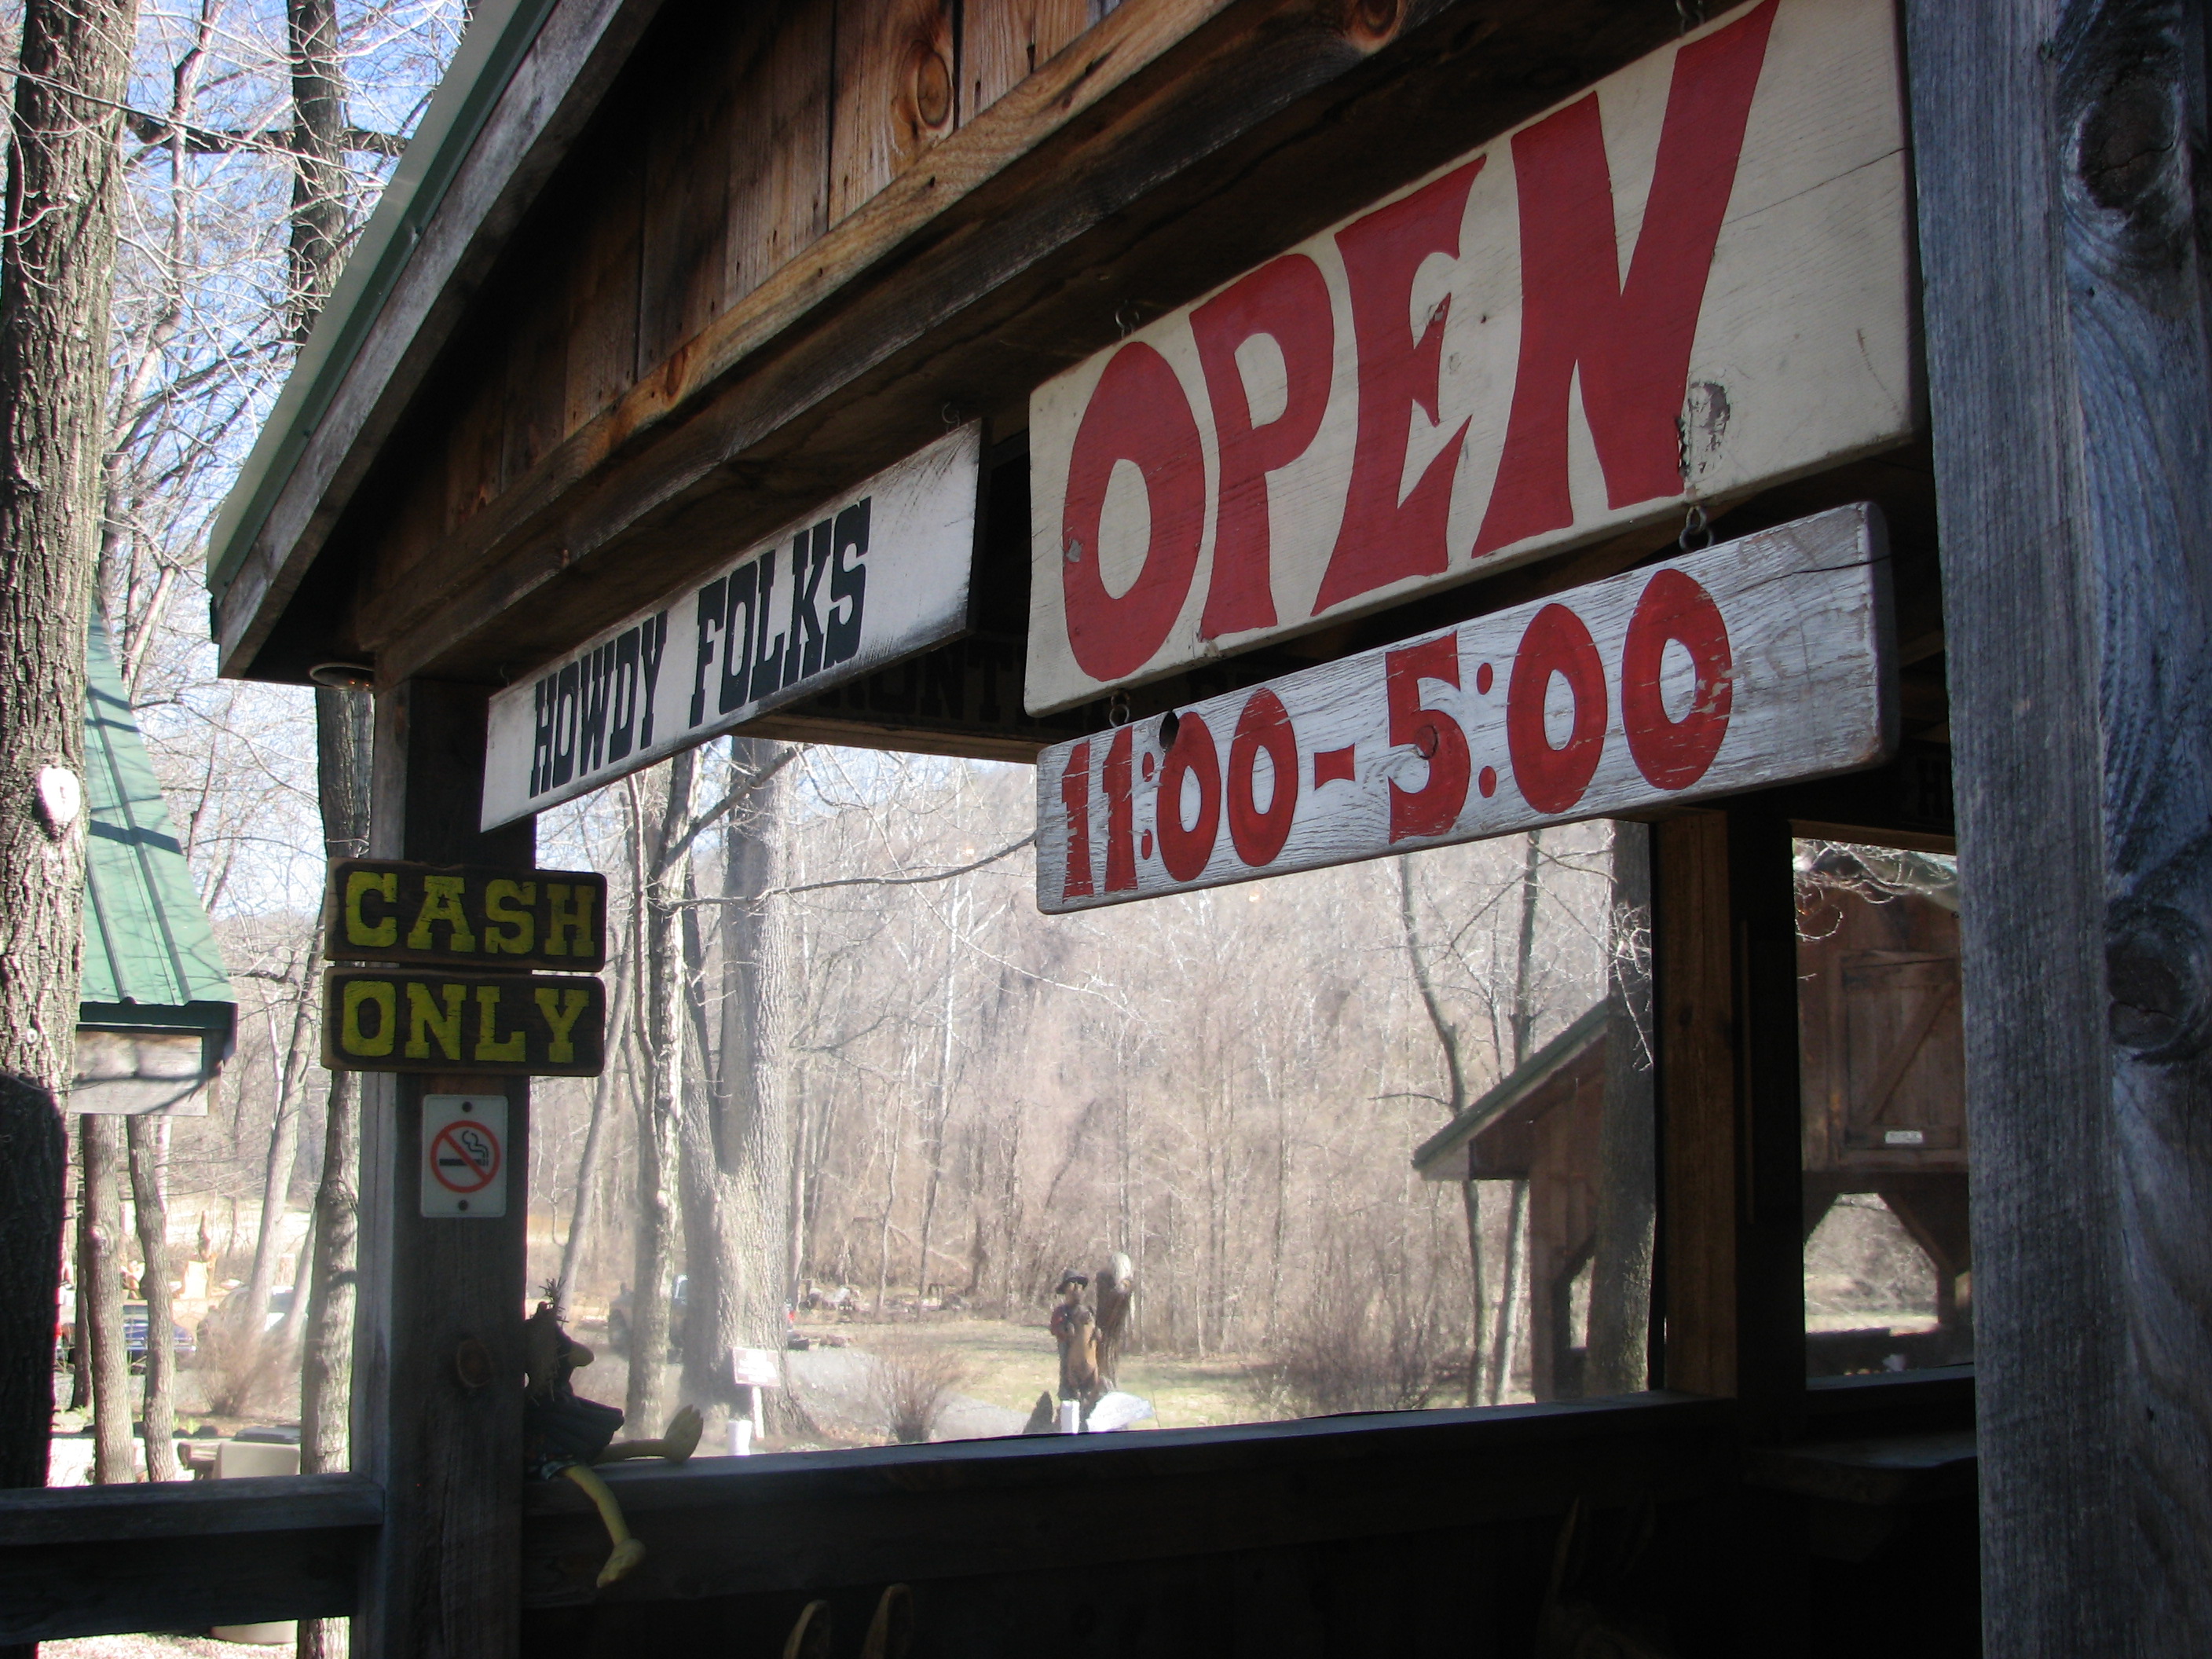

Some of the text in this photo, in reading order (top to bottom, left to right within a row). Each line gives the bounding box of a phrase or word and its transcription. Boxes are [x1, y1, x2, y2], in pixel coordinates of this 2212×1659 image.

[1062, 0, 1781, 683] OPEN
[529, 610, 668, 799] HOWDY
[688, 496, 872, 729] FOLKS
[346, 870, 596, 958] CASH
[341, 980, 590, 1064] ONLY
